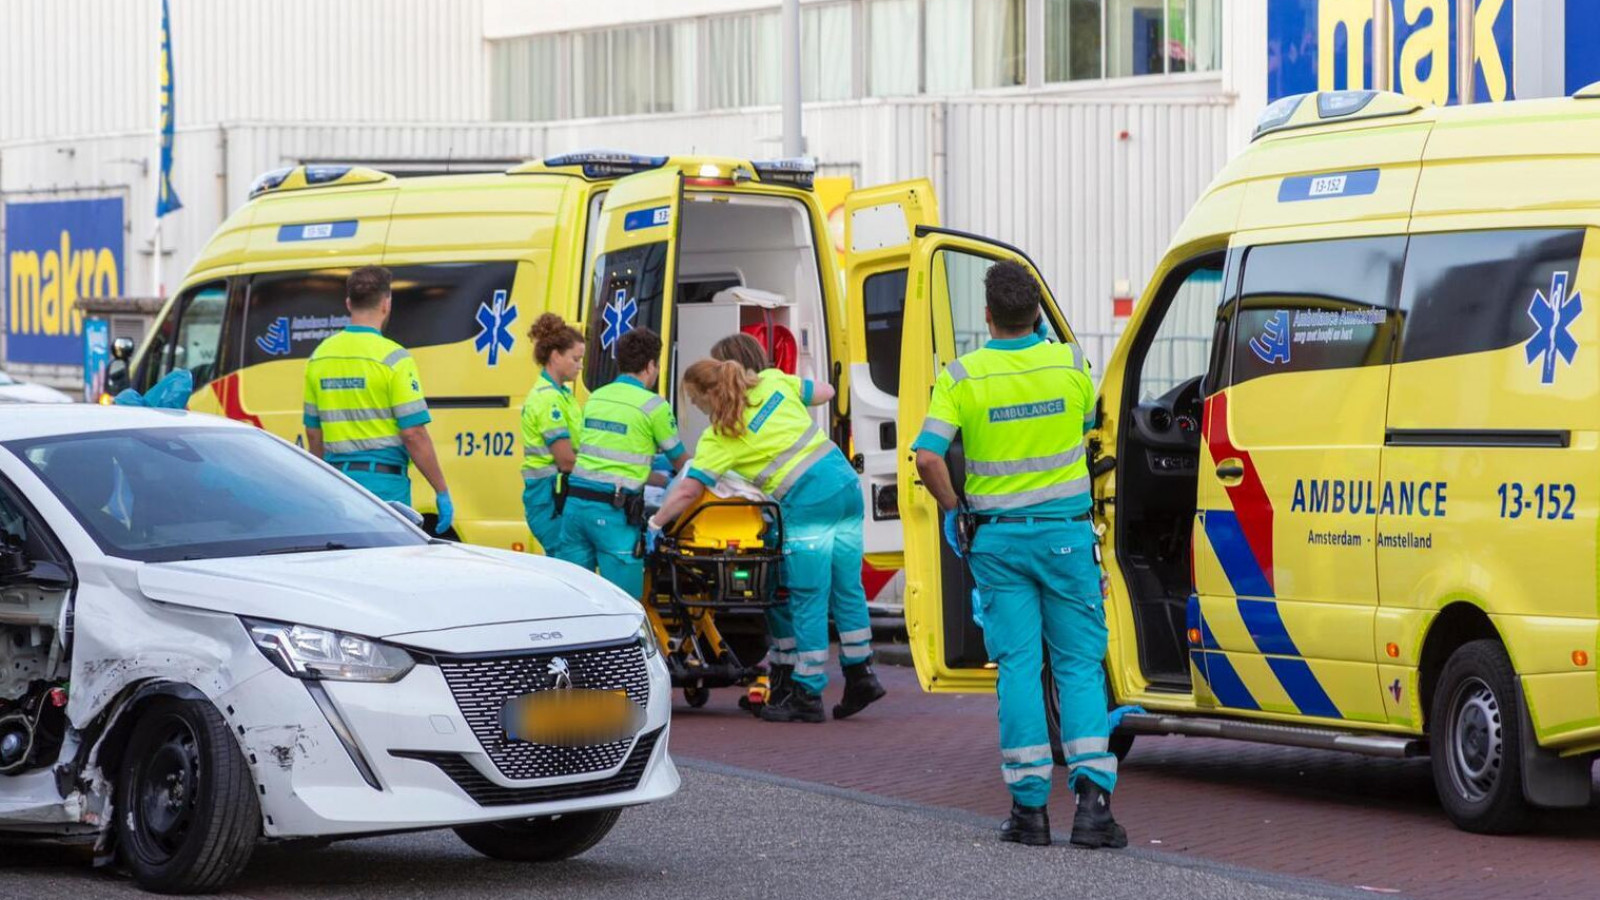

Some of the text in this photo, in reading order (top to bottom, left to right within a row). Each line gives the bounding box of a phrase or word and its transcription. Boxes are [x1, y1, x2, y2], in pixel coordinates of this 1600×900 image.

[1317, 0, 1508, 107] mak
[1315, 178, 1341, 193] 13-152
[1293, 306, 1386, 326] Ambulance Amsterdam
[992, 400, 1063, 421] AMBULANCE
[455, 432, 514, 457] 13-102
[1291, 479, 1447, 517] AMBULANCE
[1497, 482, 1576, 520] 13-152
[1307, 529, 1361, 546] Amsterdam
[1377, 532, 1432, 549] Amstelland
